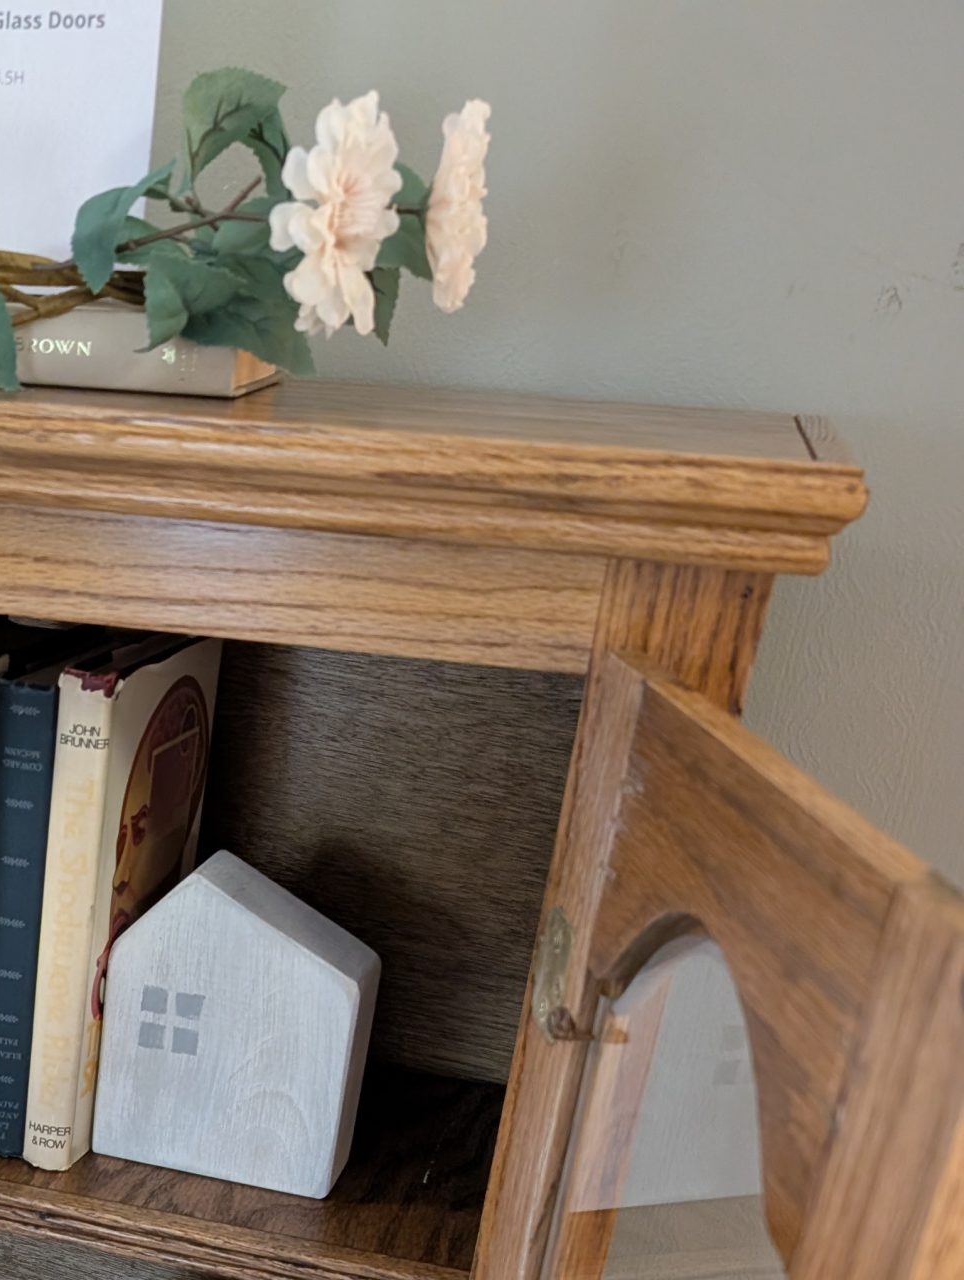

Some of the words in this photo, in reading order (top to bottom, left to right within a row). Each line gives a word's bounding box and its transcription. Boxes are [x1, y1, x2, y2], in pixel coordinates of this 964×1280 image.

[48, 10, 106, 29] Doors
[69, 723, 101, 737] JOHN
[60, 733, 110, 750] BRUNNER
[28, 1121, 71, 1136] HARPER
[31, 1135, 38, 1145] &
[39, 1136, 66, 1149] ROW
